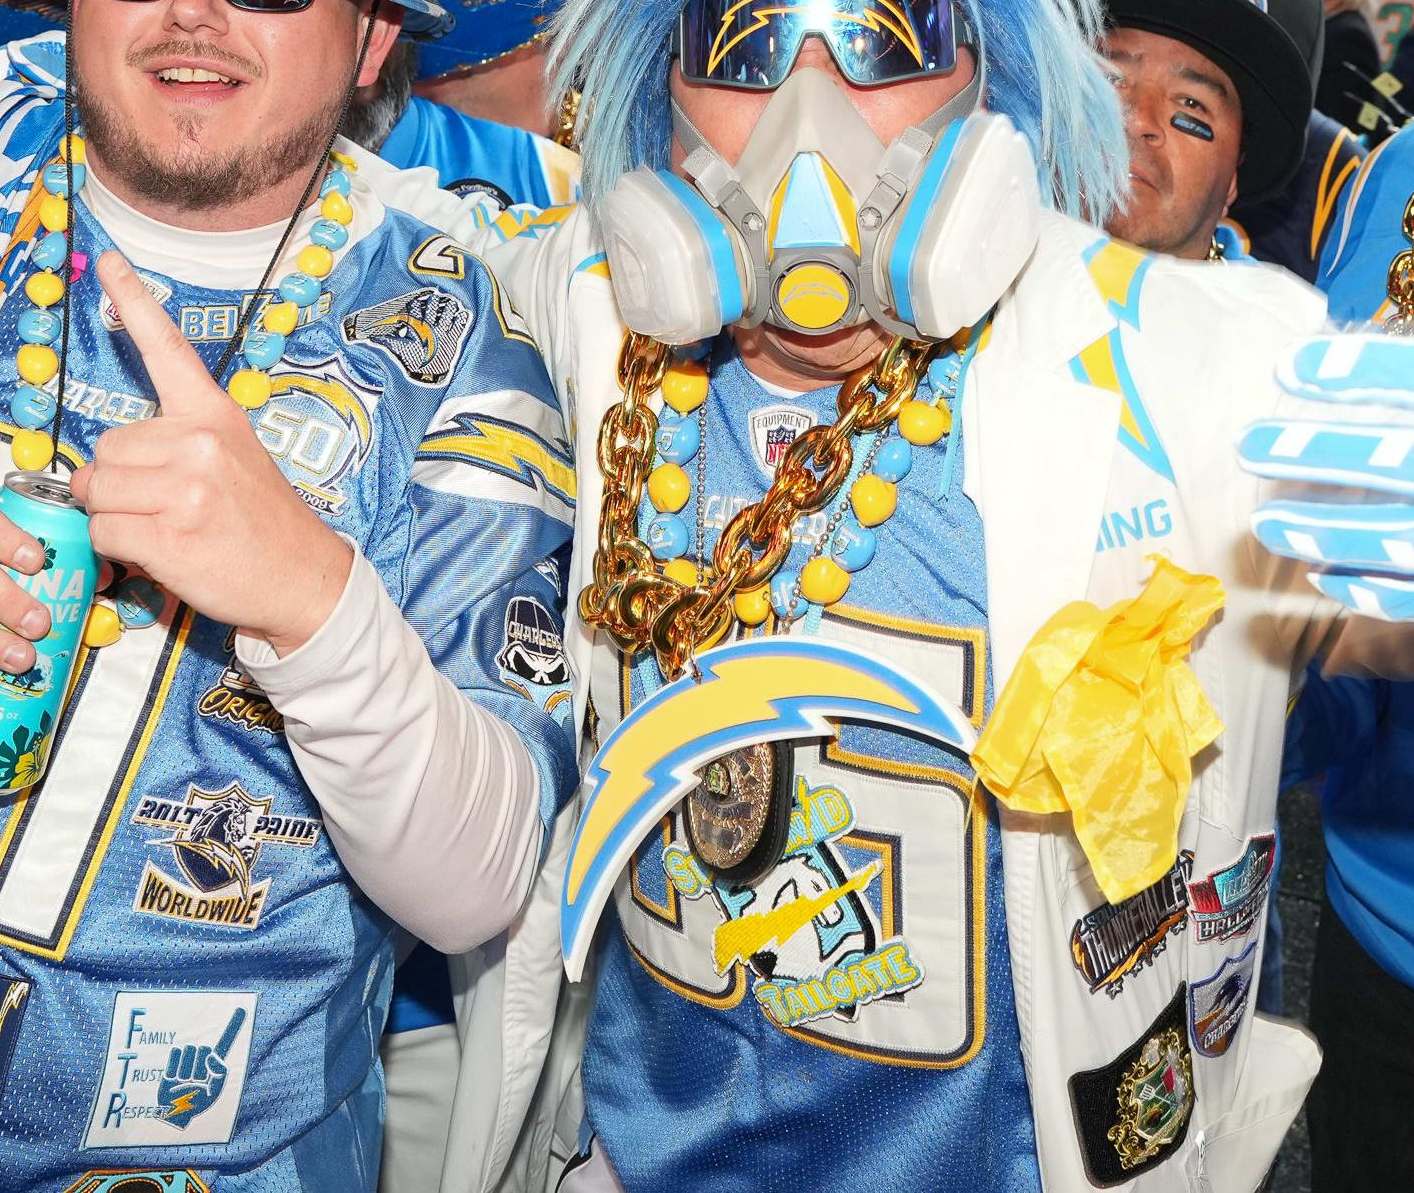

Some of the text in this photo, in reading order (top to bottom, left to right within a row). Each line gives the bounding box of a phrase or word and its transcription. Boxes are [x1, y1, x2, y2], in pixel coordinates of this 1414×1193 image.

[258, 406, 349, 476] 50
[756, 412, 809, 429] EQUIPMENT
[1094, 498, 1174, 554] ING
[200, 686, 284, 732] ORIGIN
[138, 799, 322, 840] BOLT PRIDE
[140, 868, 264, 925] WORLDWIDE
[755, 944, 919, 1023] TAILGATE
[126, 1007, 177, 1049] FAMILY
[118, 1052, 165, 1089] TRUST
